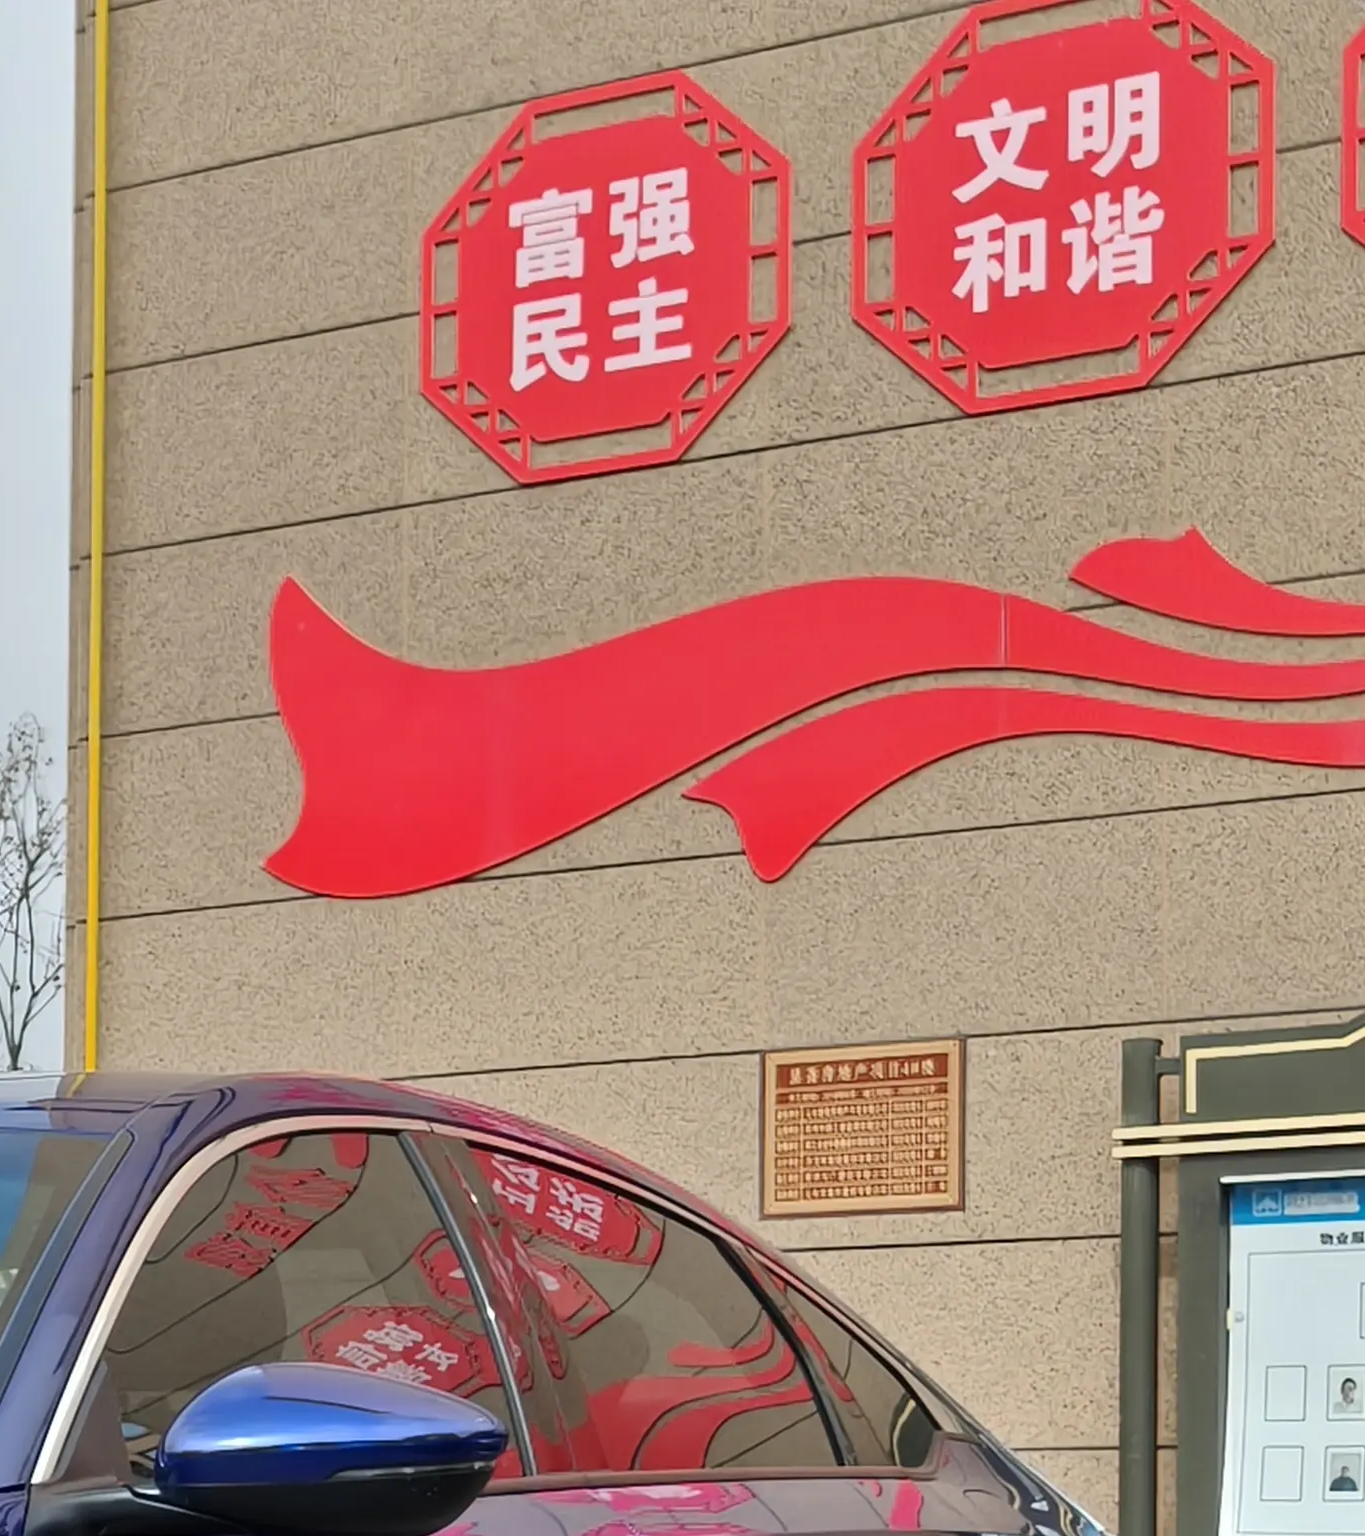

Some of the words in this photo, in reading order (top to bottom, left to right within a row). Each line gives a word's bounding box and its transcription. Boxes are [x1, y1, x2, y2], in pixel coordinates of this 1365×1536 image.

[951, 70, 1162, 205] 文明
[508, 166, 695, 289] 富强
[951, 186, 1166, 314] 和谐
[508, 279, 692, 392] 民主
